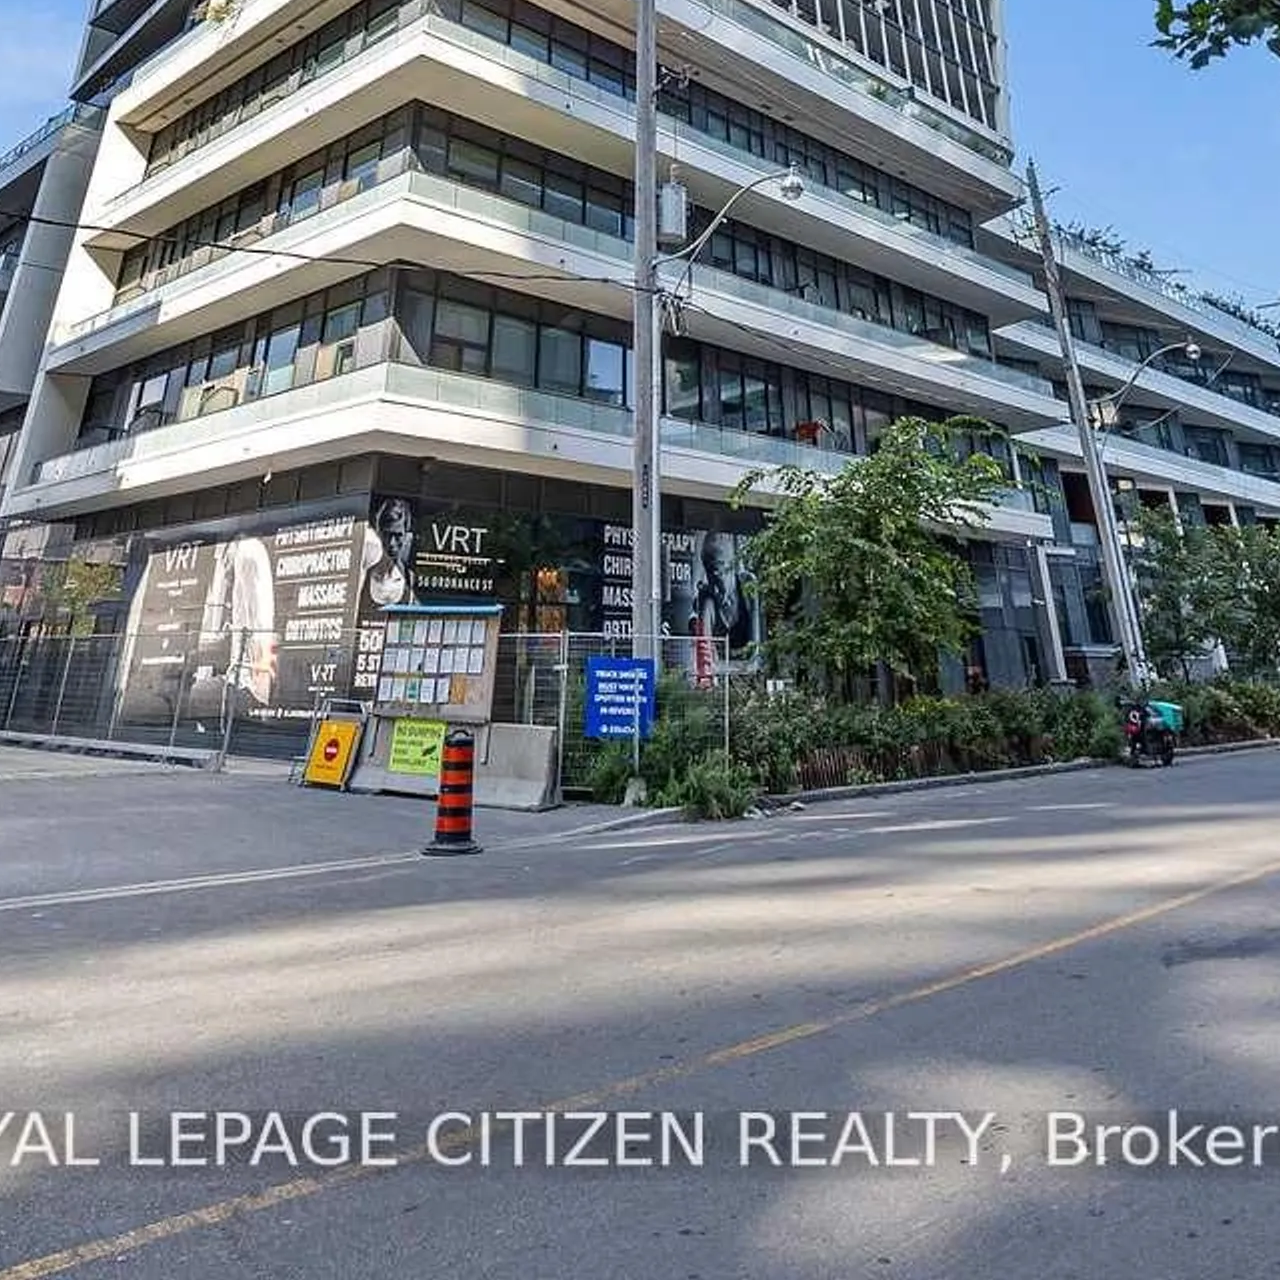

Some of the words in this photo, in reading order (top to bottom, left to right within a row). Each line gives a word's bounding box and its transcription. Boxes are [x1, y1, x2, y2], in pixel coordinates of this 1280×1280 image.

[431, 523, 489, 553] VRT
[604, 525, 696, 553] PHYSERAPY
[165, 541, 205, 573] VRT
[603, 556, 691, 580] CHIRTOR
[298, 583, 347, 608] MASSAGE
[311, 664, 337, 682] VRT
